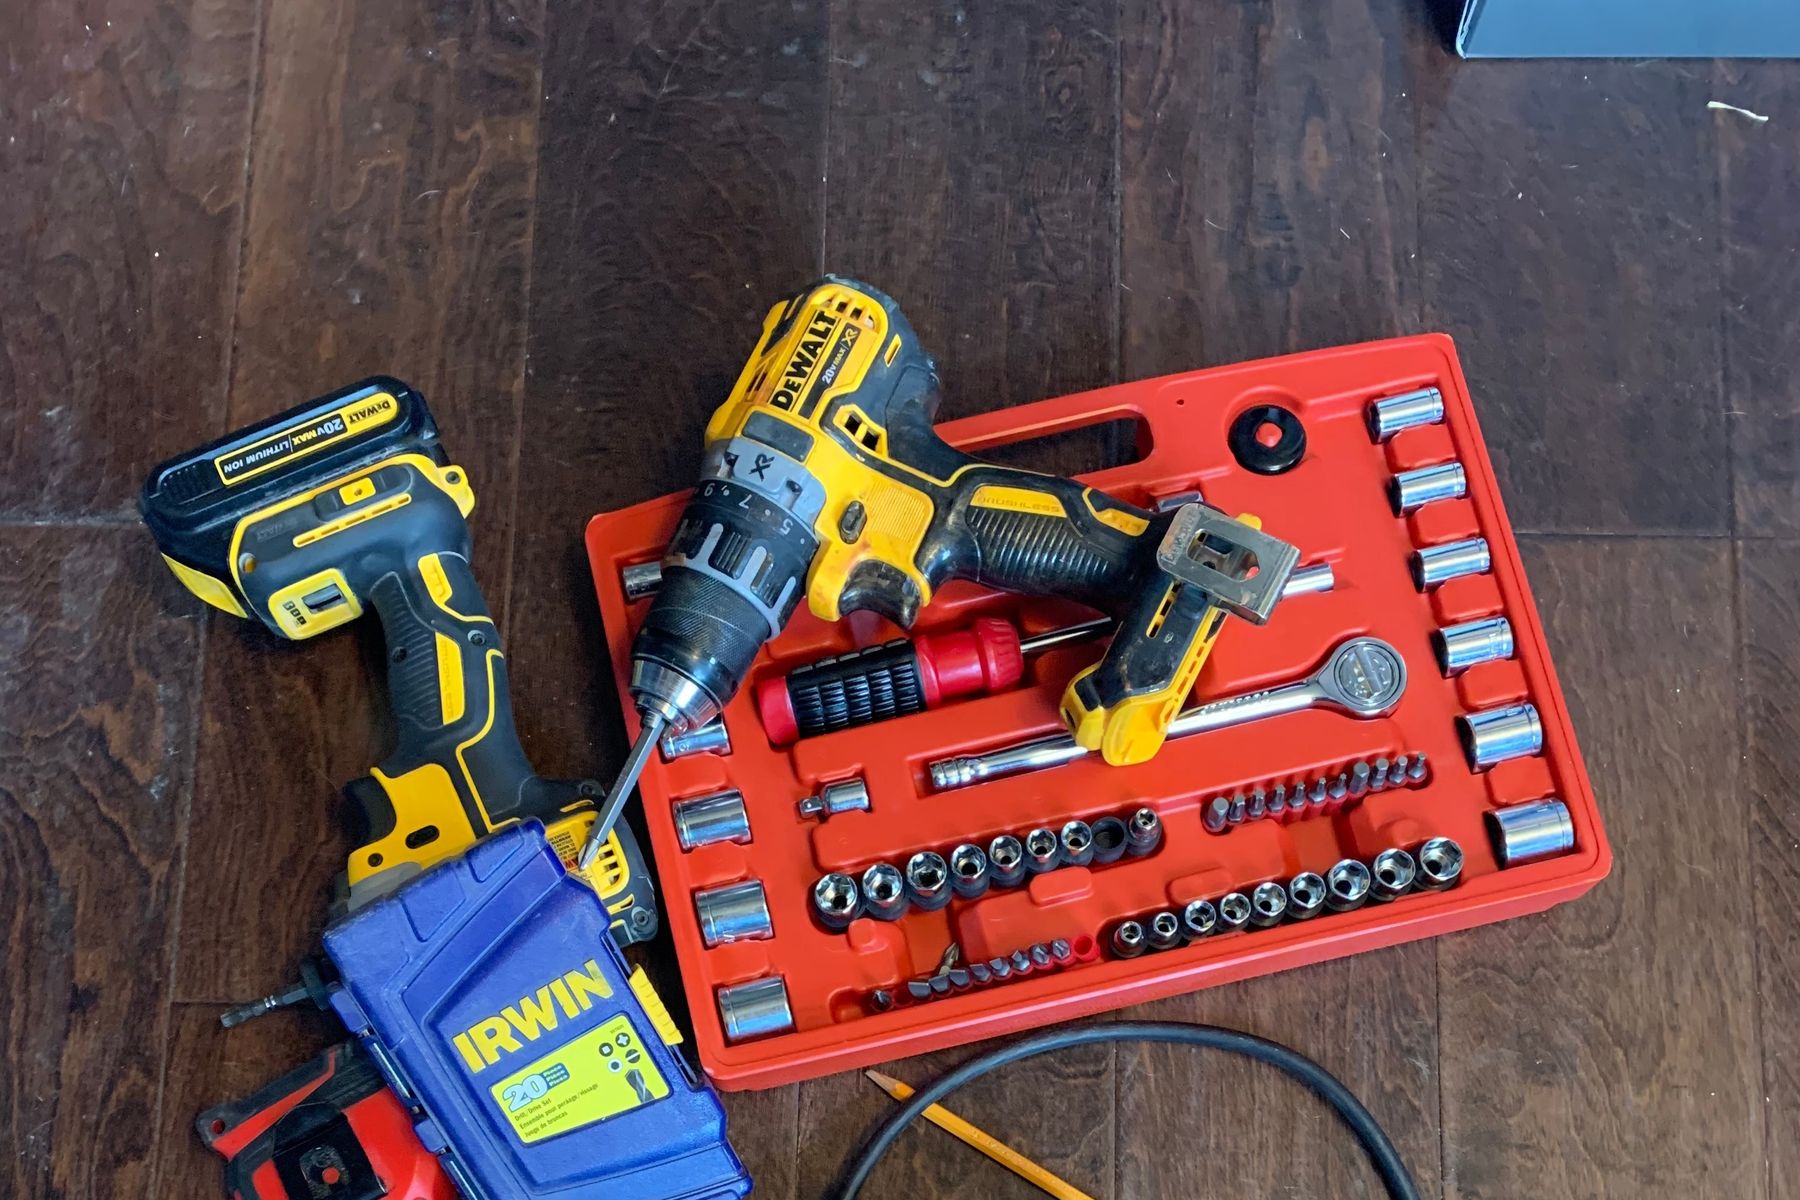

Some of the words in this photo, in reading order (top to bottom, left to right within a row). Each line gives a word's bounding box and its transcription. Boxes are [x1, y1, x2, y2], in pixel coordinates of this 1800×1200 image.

[223, 459, 243, 473] ION
[245, 441, 289, 464] LITHIUM
[452, 959, 614, 1073] IRWIN
[502, 1073, 549, 1112] 20
